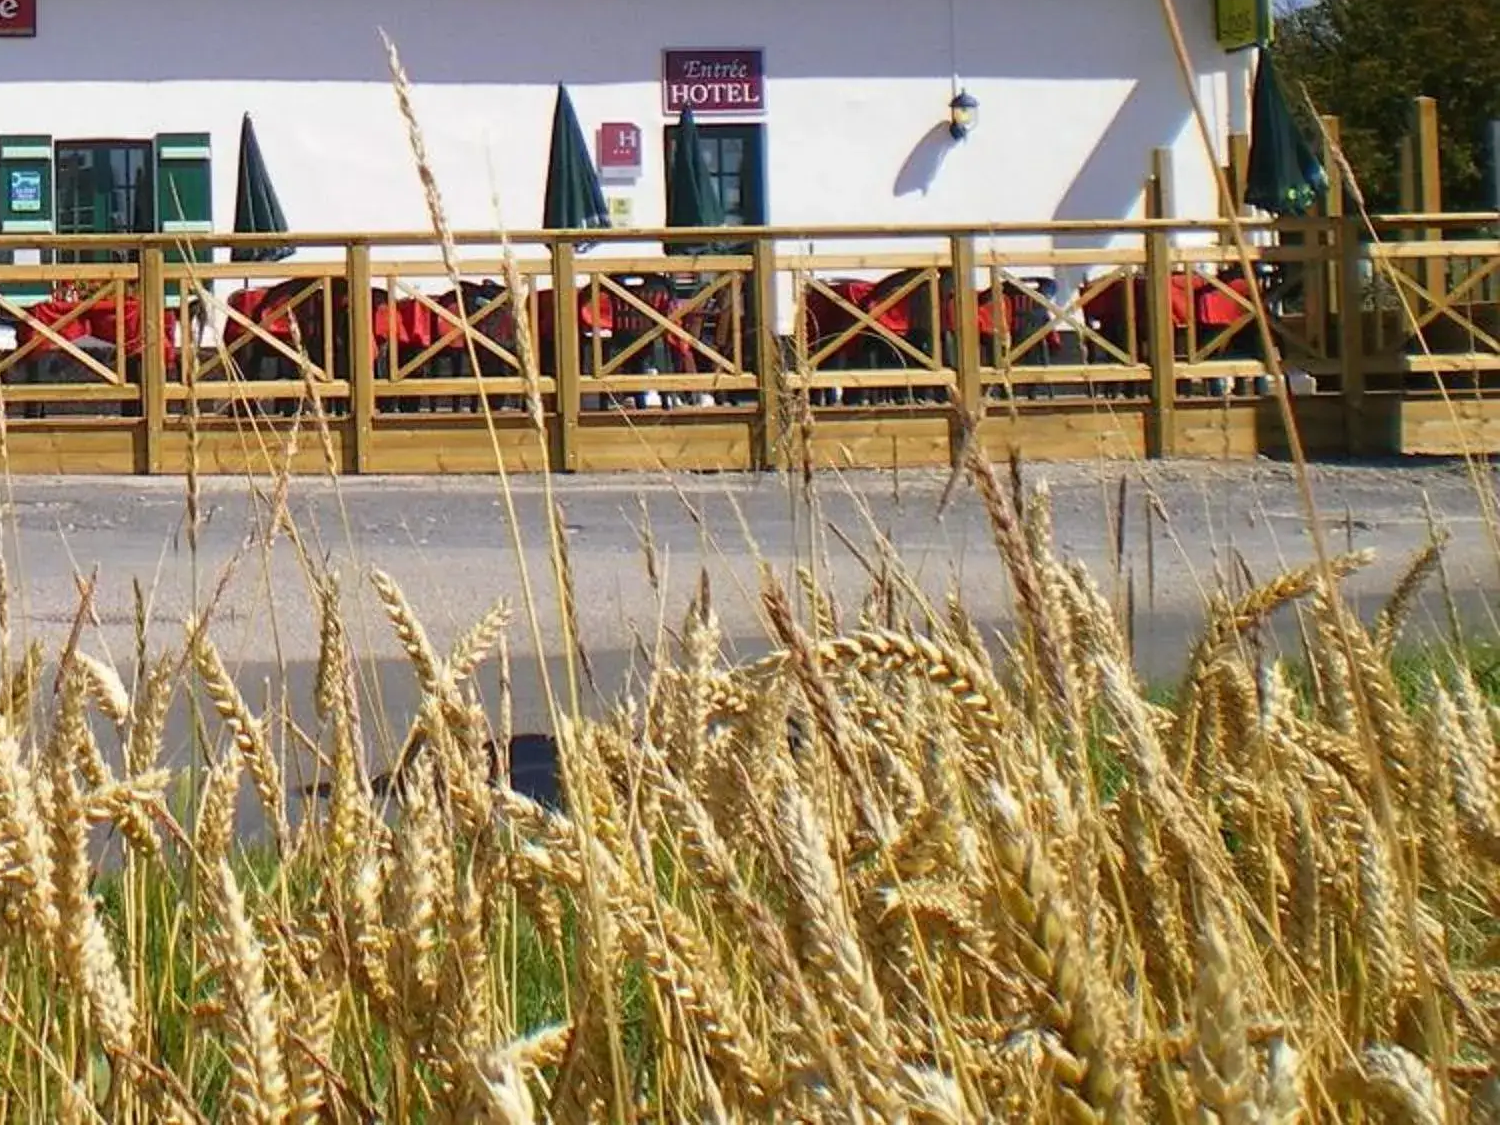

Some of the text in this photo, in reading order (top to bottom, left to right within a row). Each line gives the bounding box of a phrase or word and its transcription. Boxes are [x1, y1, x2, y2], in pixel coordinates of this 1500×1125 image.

[684, 59, 748, 79] Entrée
[671, 82, 760, 103] HOTEL
[619, 130, 637, 148] H
